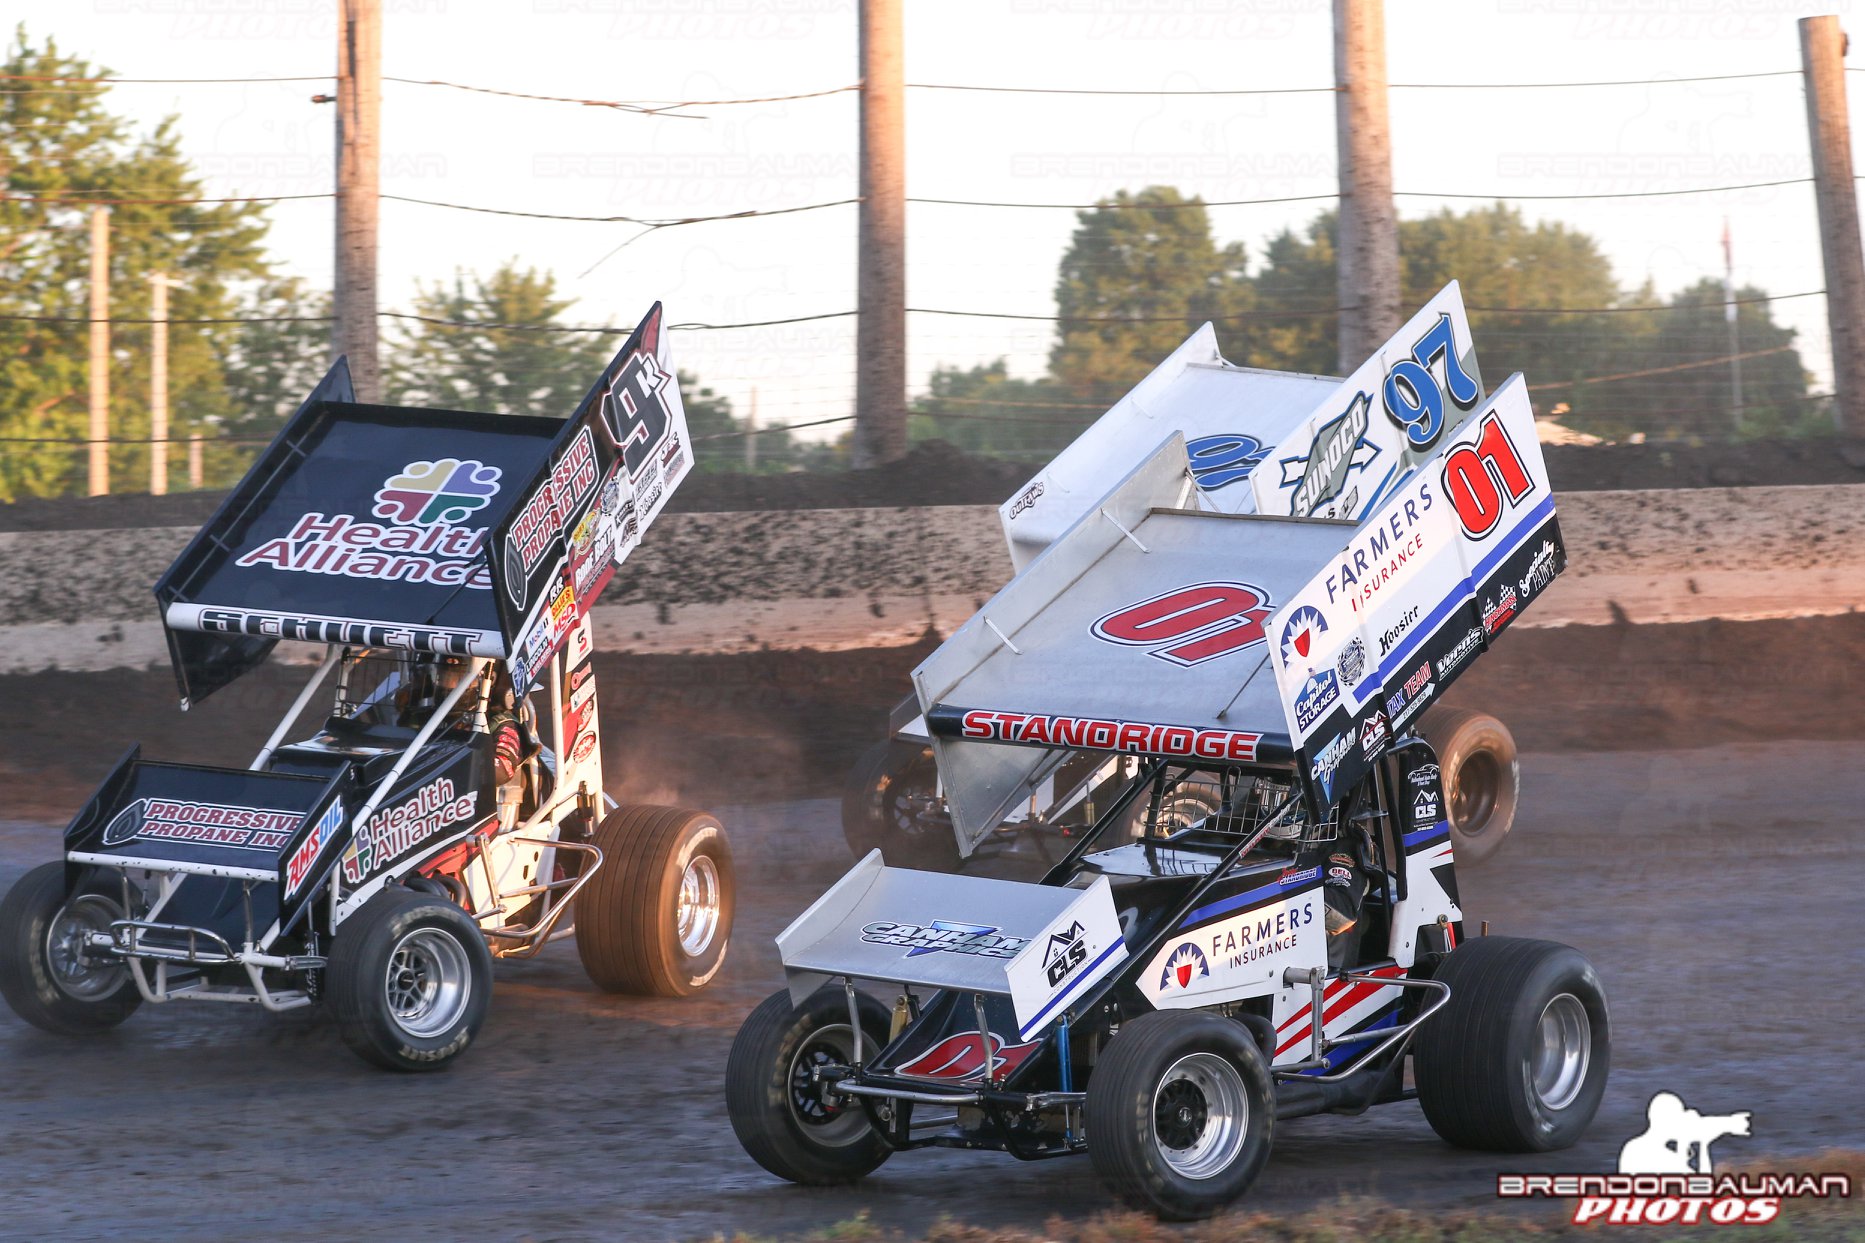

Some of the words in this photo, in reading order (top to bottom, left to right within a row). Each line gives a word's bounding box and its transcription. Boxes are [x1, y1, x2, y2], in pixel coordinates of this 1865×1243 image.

[1384, 311, 1479, 453] 97
[1295, 398, 1368, 517] SUNOCO
[1441, 409, 1536, 542] 01
[512, 432, 593, 550] PROGRESSIVE
[521, 485, 574, 571] PROPANE
[572, 457, 597, 503] INC
[1009, 482, 1046, 520] OUTLAWS
[235, 537, 493, 590] Alliance
[1325, 483, 1433, 605] FARMERS
[1297, 671, 1333, 717] Capitol
[1404, 660, 1432, 700] TEAM
[1299, 687, 1337, 731] STORAGE
[961, 709, 1264, 763] STANDRIDGE
[1310, 727, 1356, 782] CANHAM
[1362, 721, 1386, 752] CLS
[138, 821, 250, 844] PROPANE
[143, 800, 304, 831] PROGRESSIVE
[370, 778, 455, 841] Health
[373, 798, 475, 871] Alliance
[1415, 803, 1437, 819] CLS
[284, 793, 345, 904] AMSOIL
[861, 921, 1033, 951] CANHAM
[861, 933, 1022, 960] GRAPHICS
[1212, 902, 1314, 957] FARMERS
[1229, 934, 1298, 969] INSURANCE
[1046, 939, 1087, 988] CLS
